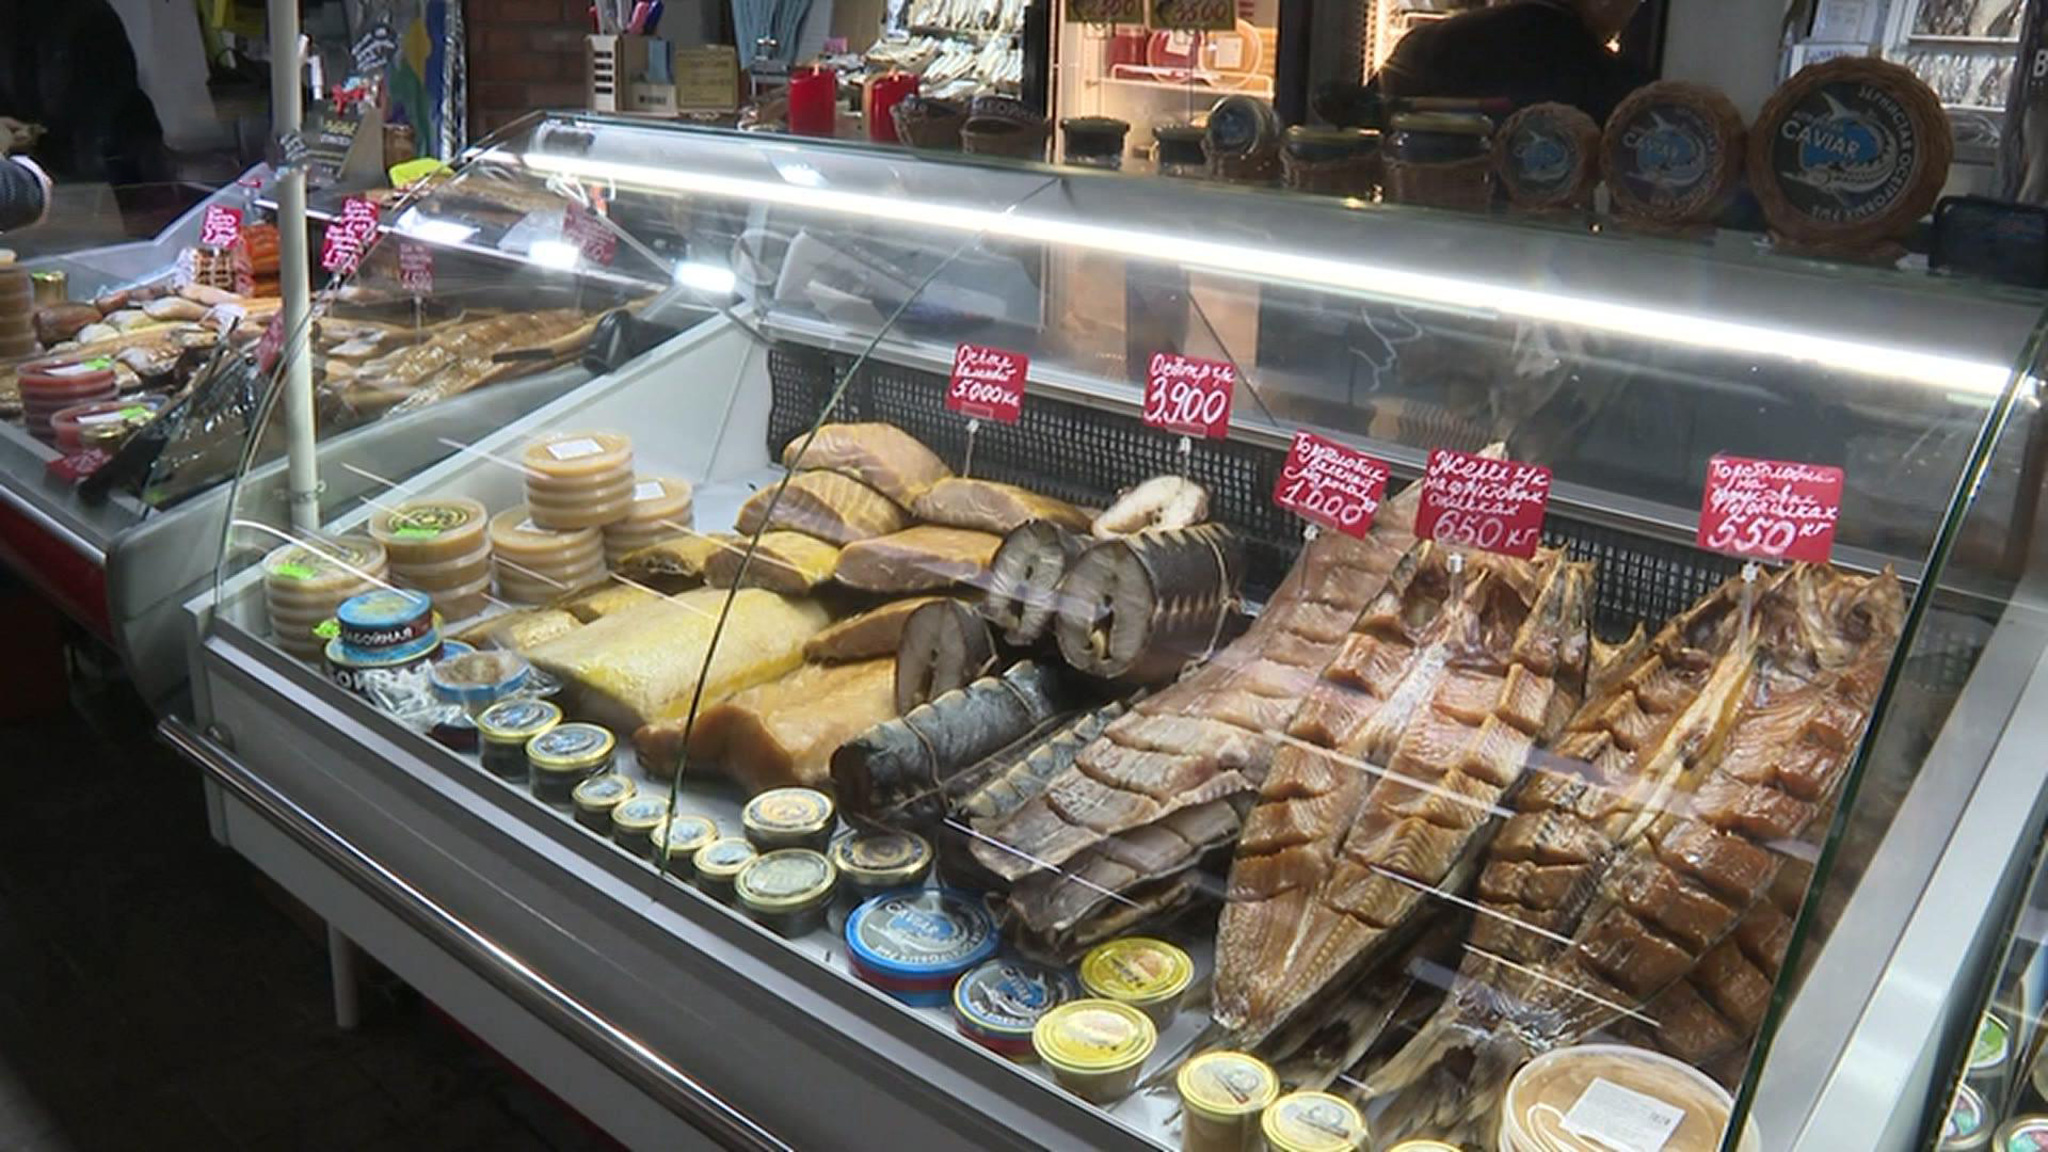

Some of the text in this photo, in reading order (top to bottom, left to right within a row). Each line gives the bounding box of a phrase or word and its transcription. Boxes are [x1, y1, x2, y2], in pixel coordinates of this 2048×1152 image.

[1781, 119, 1861, 160] CAVIAR
[1432, 509, 1504, 549] 650
[1706, 513, 1797, 555] 550
